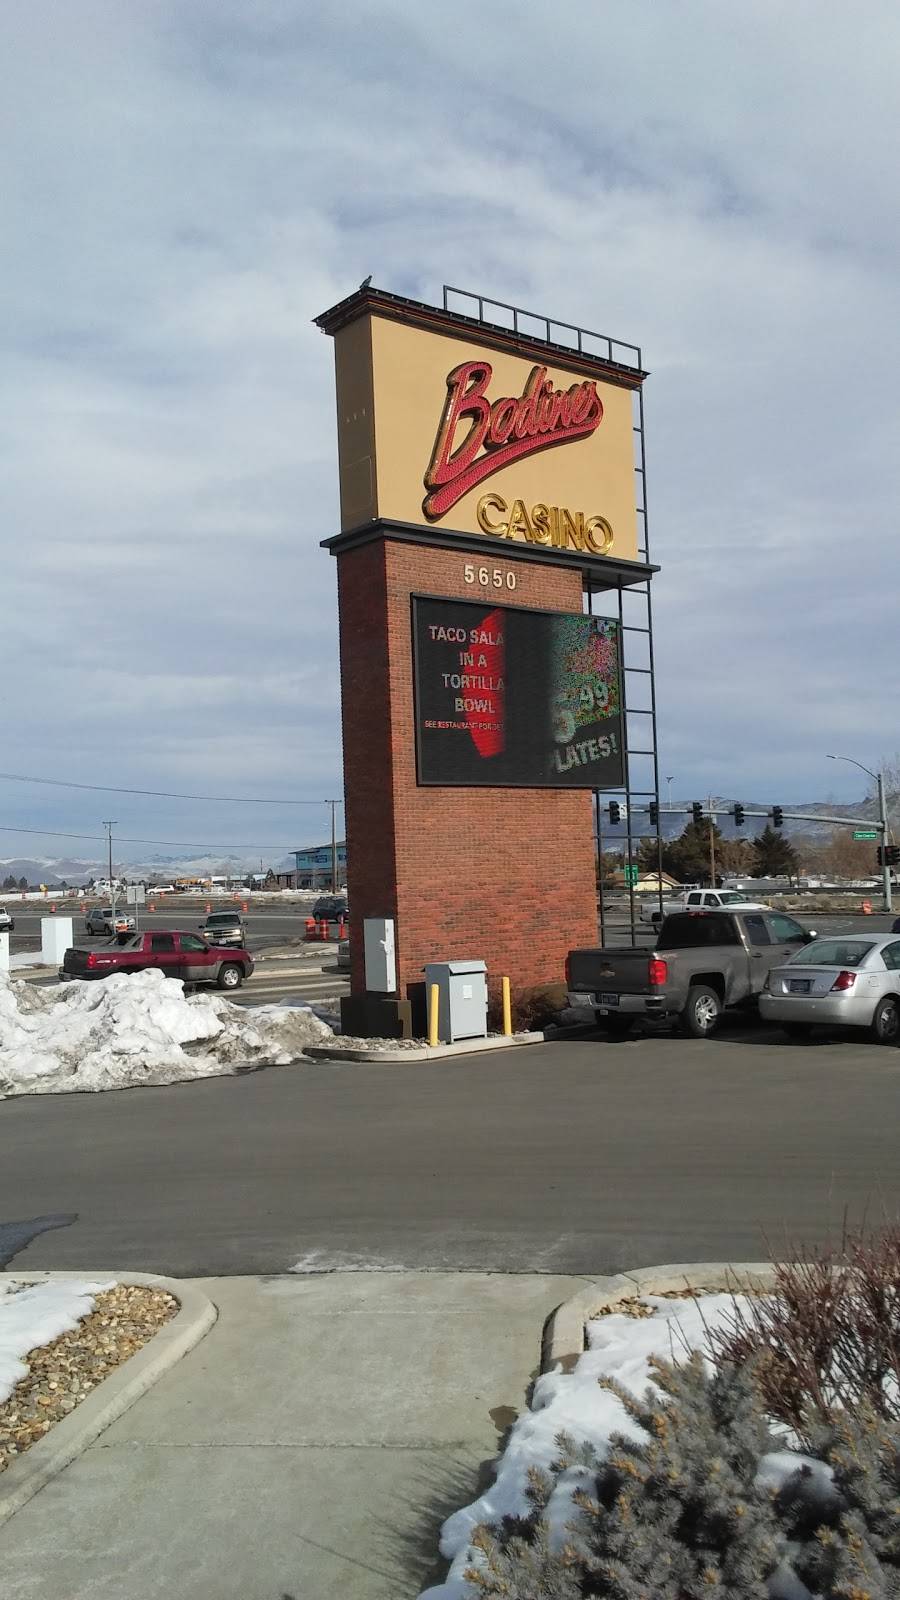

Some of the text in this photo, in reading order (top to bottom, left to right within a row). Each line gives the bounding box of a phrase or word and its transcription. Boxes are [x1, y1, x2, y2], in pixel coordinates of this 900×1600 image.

[476, 493, 614, 555] CASINO
[463, 564, 516, 590] 5650
[428, 625, 467, 643] TACO
[459, 651, 488, 668] IN A
[441, 673, 505, 691] TORTILLA
[454, 697, 496, 713] BOWL
[424, 720, 437, 728] SEE
[553, 733, 618, 773] LATES!
